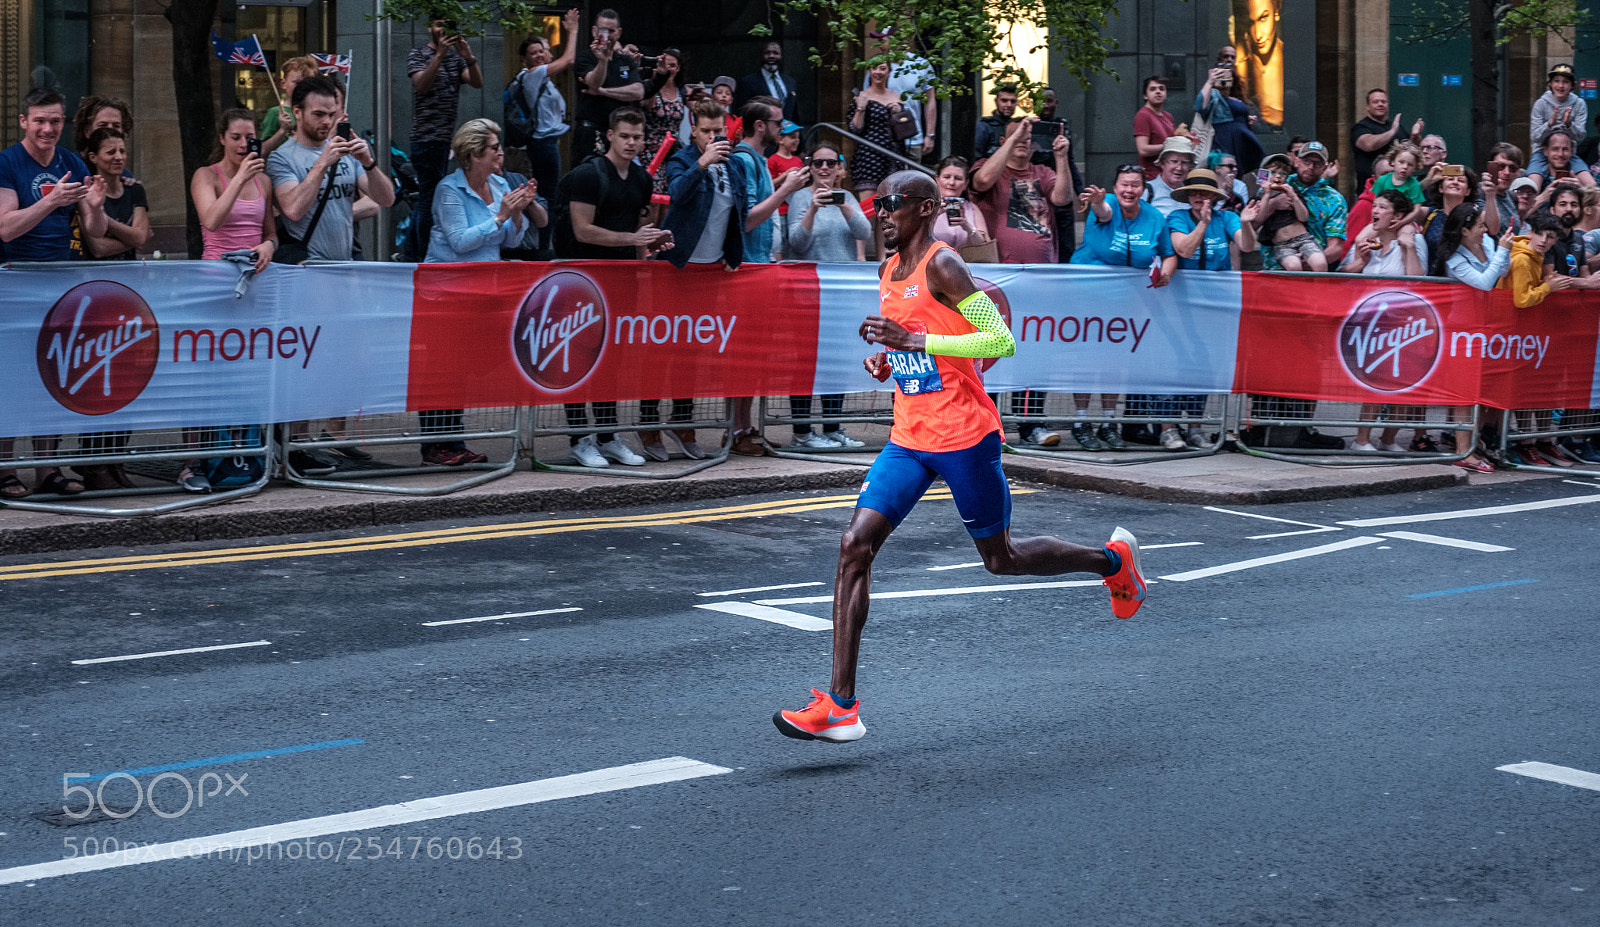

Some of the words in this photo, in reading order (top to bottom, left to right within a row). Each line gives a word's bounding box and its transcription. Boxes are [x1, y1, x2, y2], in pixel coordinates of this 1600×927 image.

[46, 295, 153, 396] Virgin
[172, 324, 322, 369] money
[521, 285, 601, 372] Virgin
[614, 314, 737, 353] money
[1020, 315, 1151, 353] money
[1347, 302, 1434, 377] Virgin
[1449, 331, 1550, 369] money
